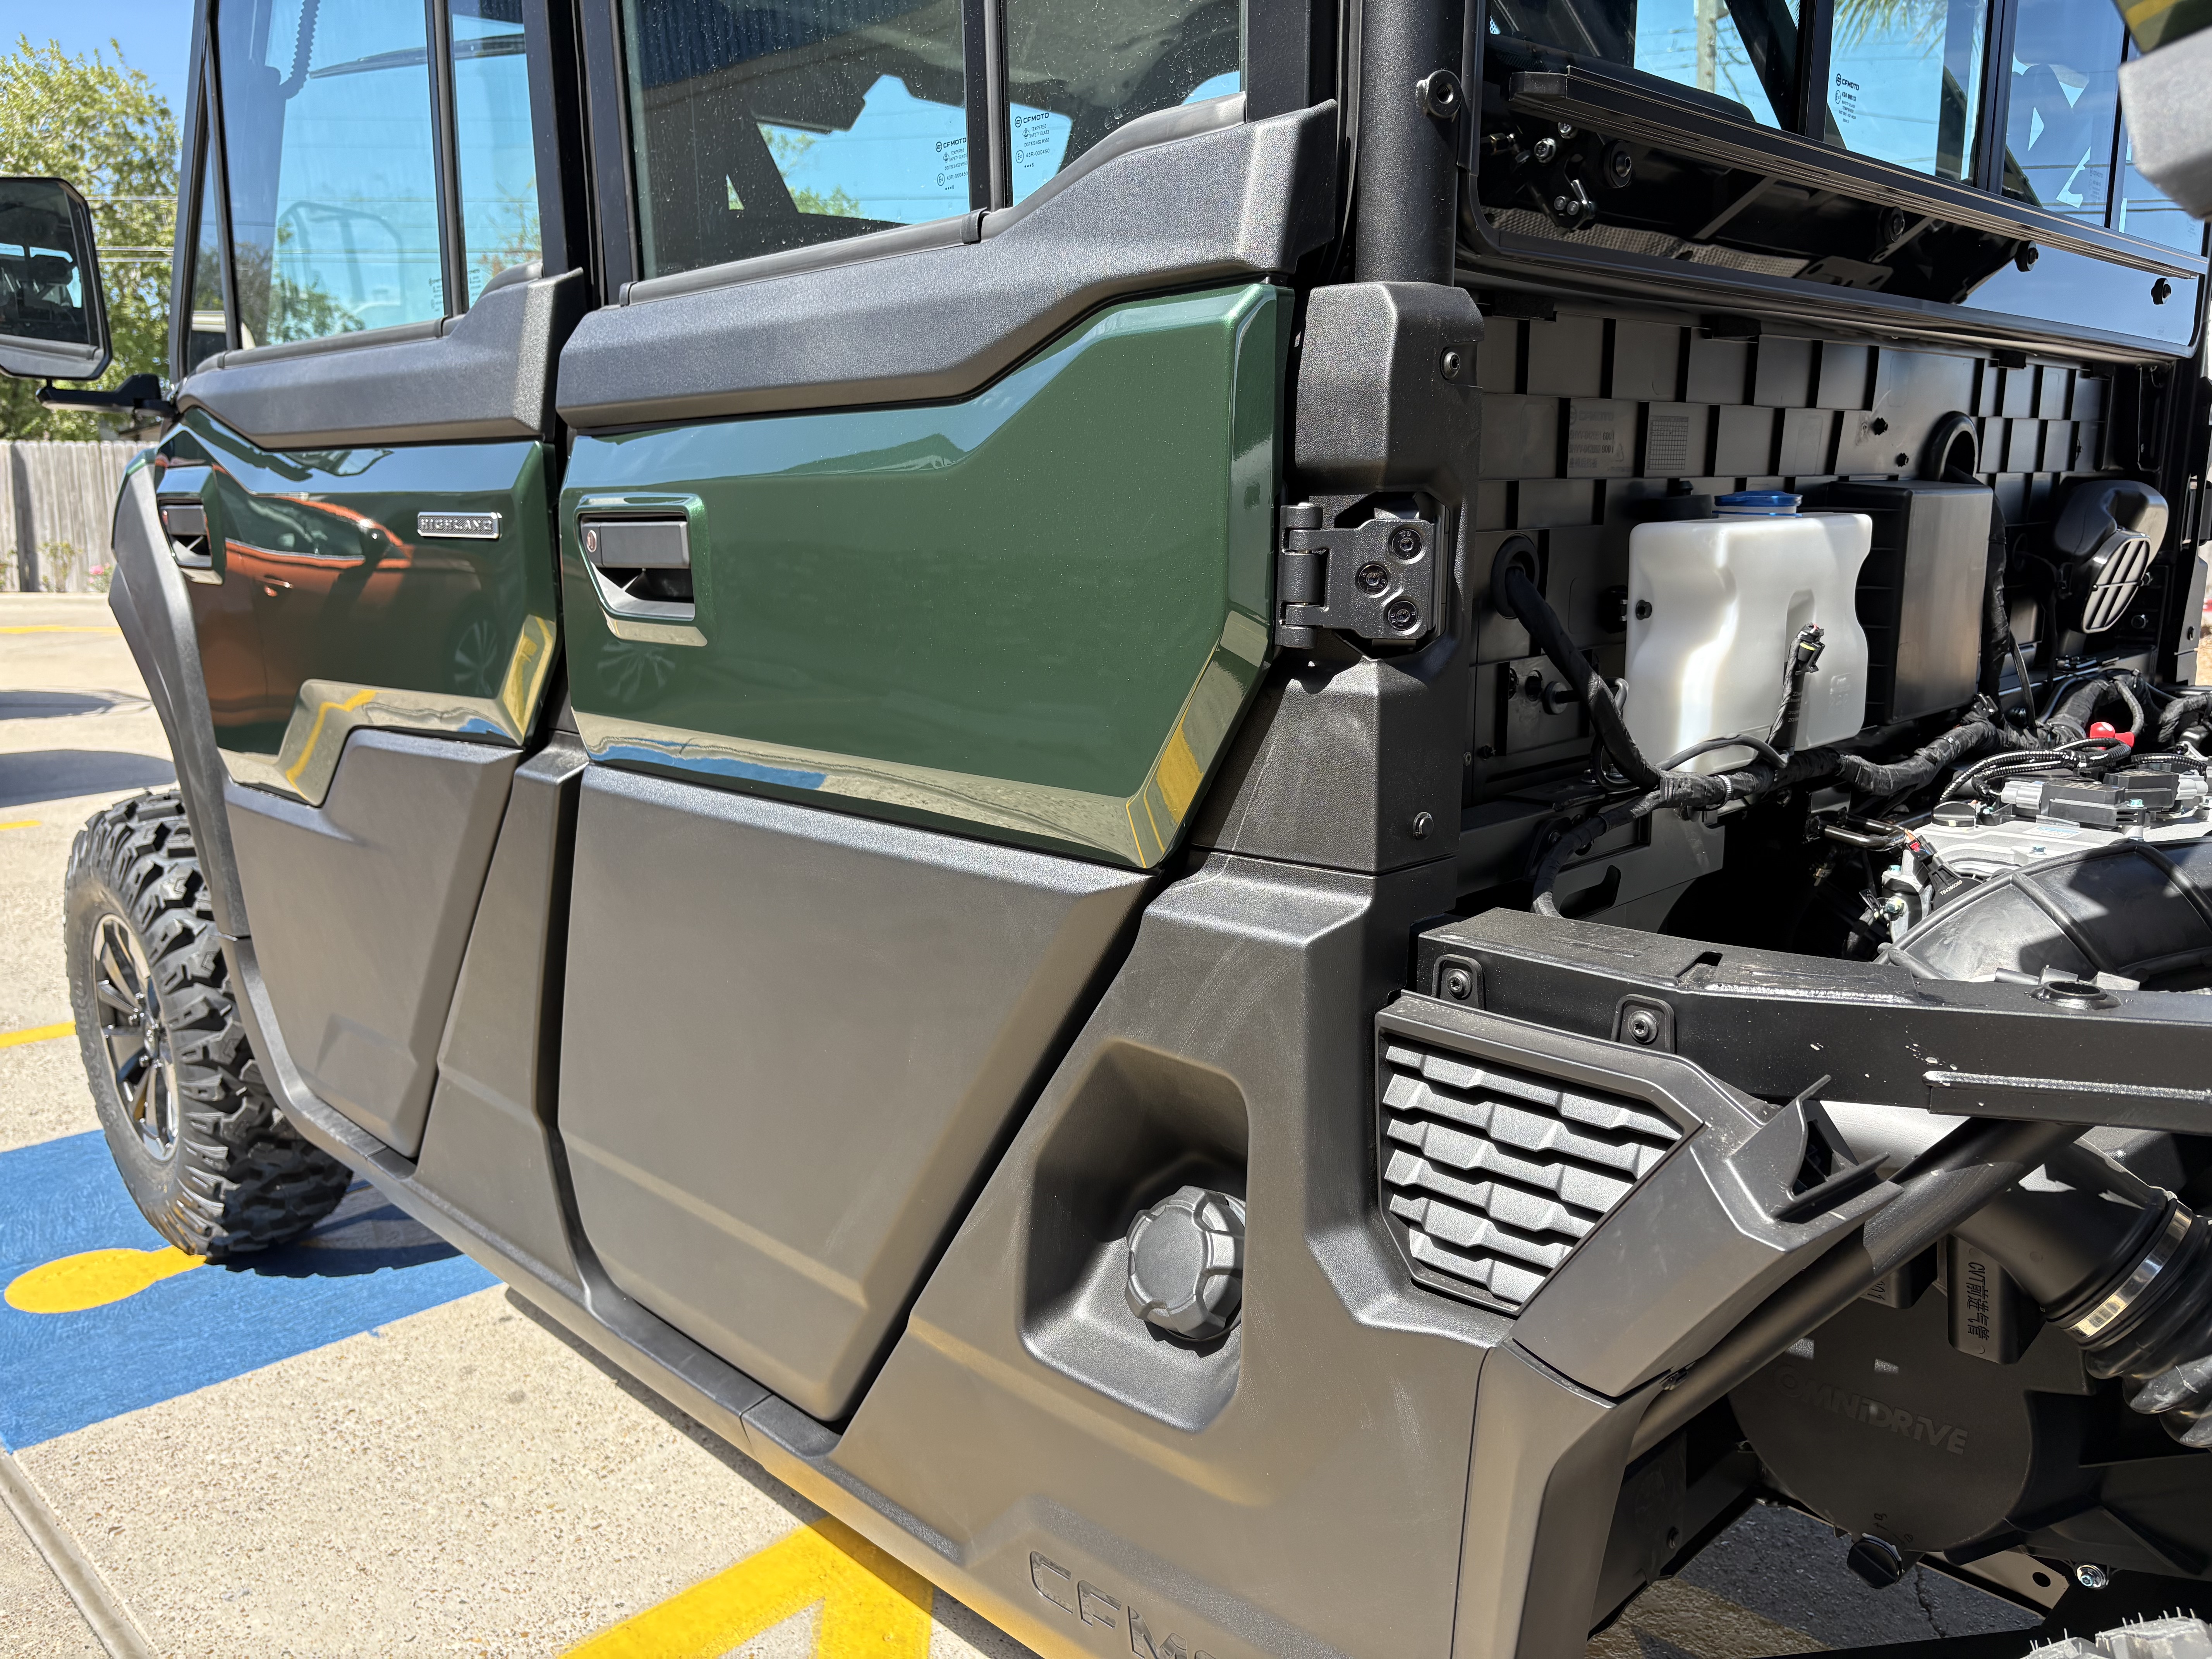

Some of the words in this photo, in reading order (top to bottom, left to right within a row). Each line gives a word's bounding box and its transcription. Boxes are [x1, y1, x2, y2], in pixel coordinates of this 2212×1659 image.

[1842, 78, 1859, 91] CFMOTO
[1023, 112, 1049, 124] CFMOTO
[943, 137, 967, 148] CFMOTO
[421, 519, 492, 531] HIGHLAND
[1966, 1262, 1990, 1341] CVT前进气管
[1029, 1551, 1217, 1659] CFM
